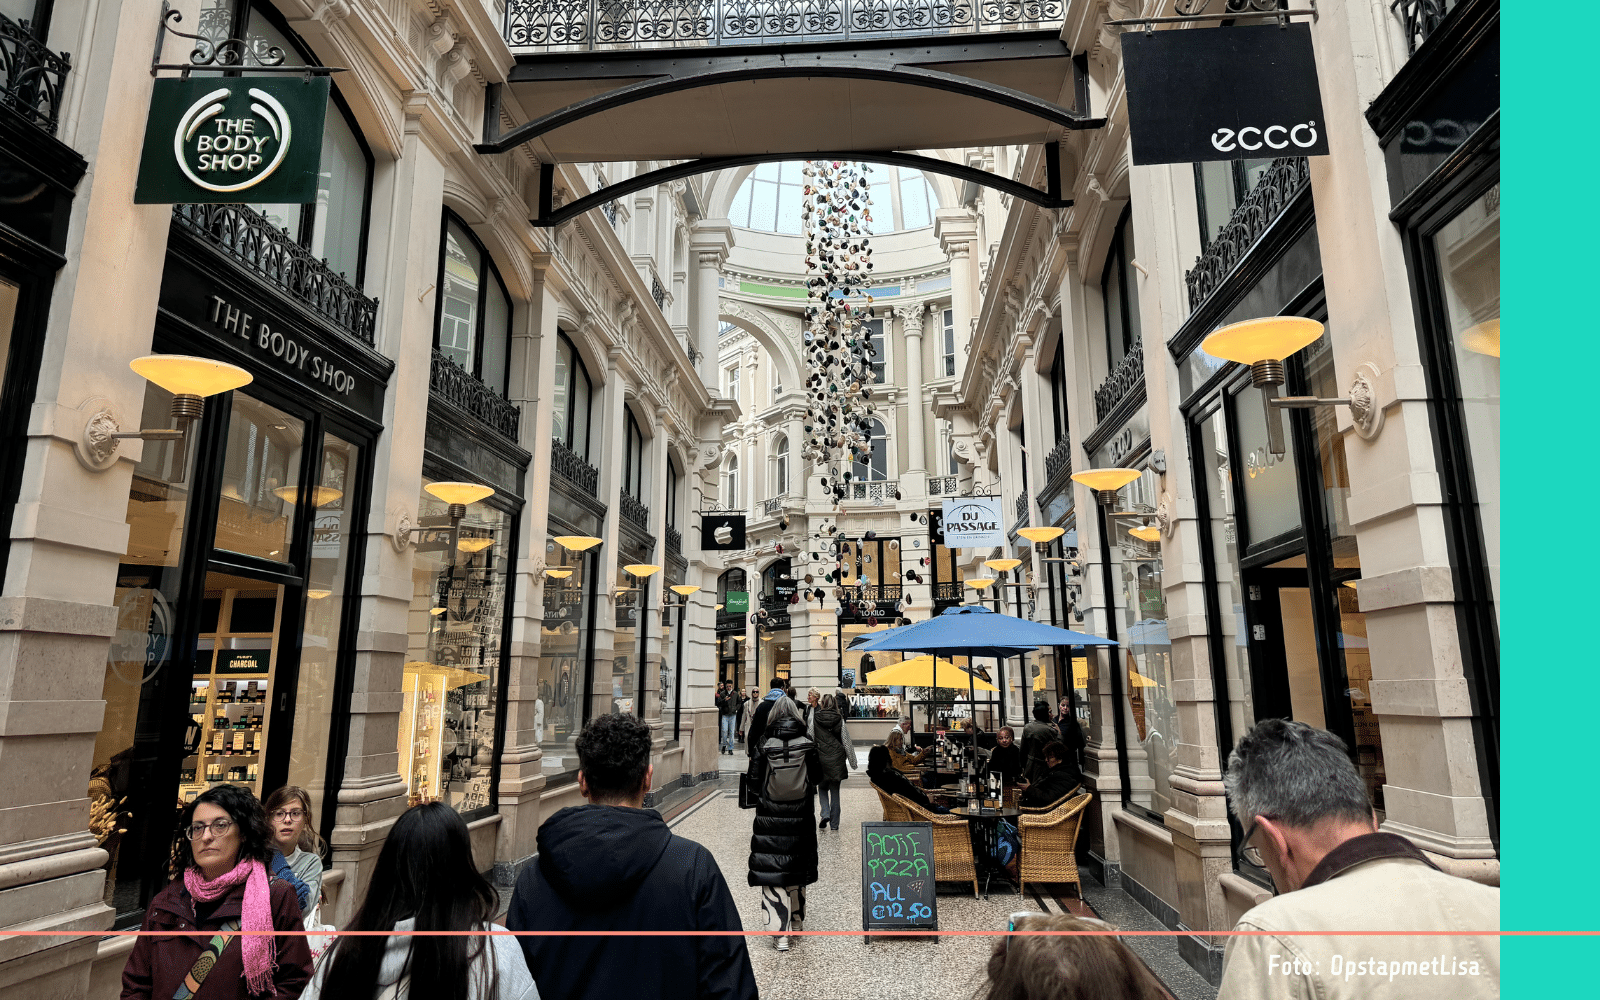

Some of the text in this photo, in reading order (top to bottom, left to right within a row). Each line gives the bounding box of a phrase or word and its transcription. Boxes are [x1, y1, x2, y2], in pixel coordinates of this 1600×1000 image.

[214, 118, 255, 134] THE
[197, 134, 270, 153] BODY
[1211, 123, 1318, 152] ecco
[197, 153, 262, 171] SHOP
[210, 295, 355, 396] THE BODY SHOP
[962, 512, 978, 521] DU
[946, 522, 1000, 532] PASSAGE
[871, 609, 885, 617] KILO
[460, 646, 481, 657] LOVE
[229, 659, 258, 668] CHARCOAL
[466, 694, 488, 706] HERE
[848, 693, 899, 709] vintage
[870, 881, 905, 901] ALL
